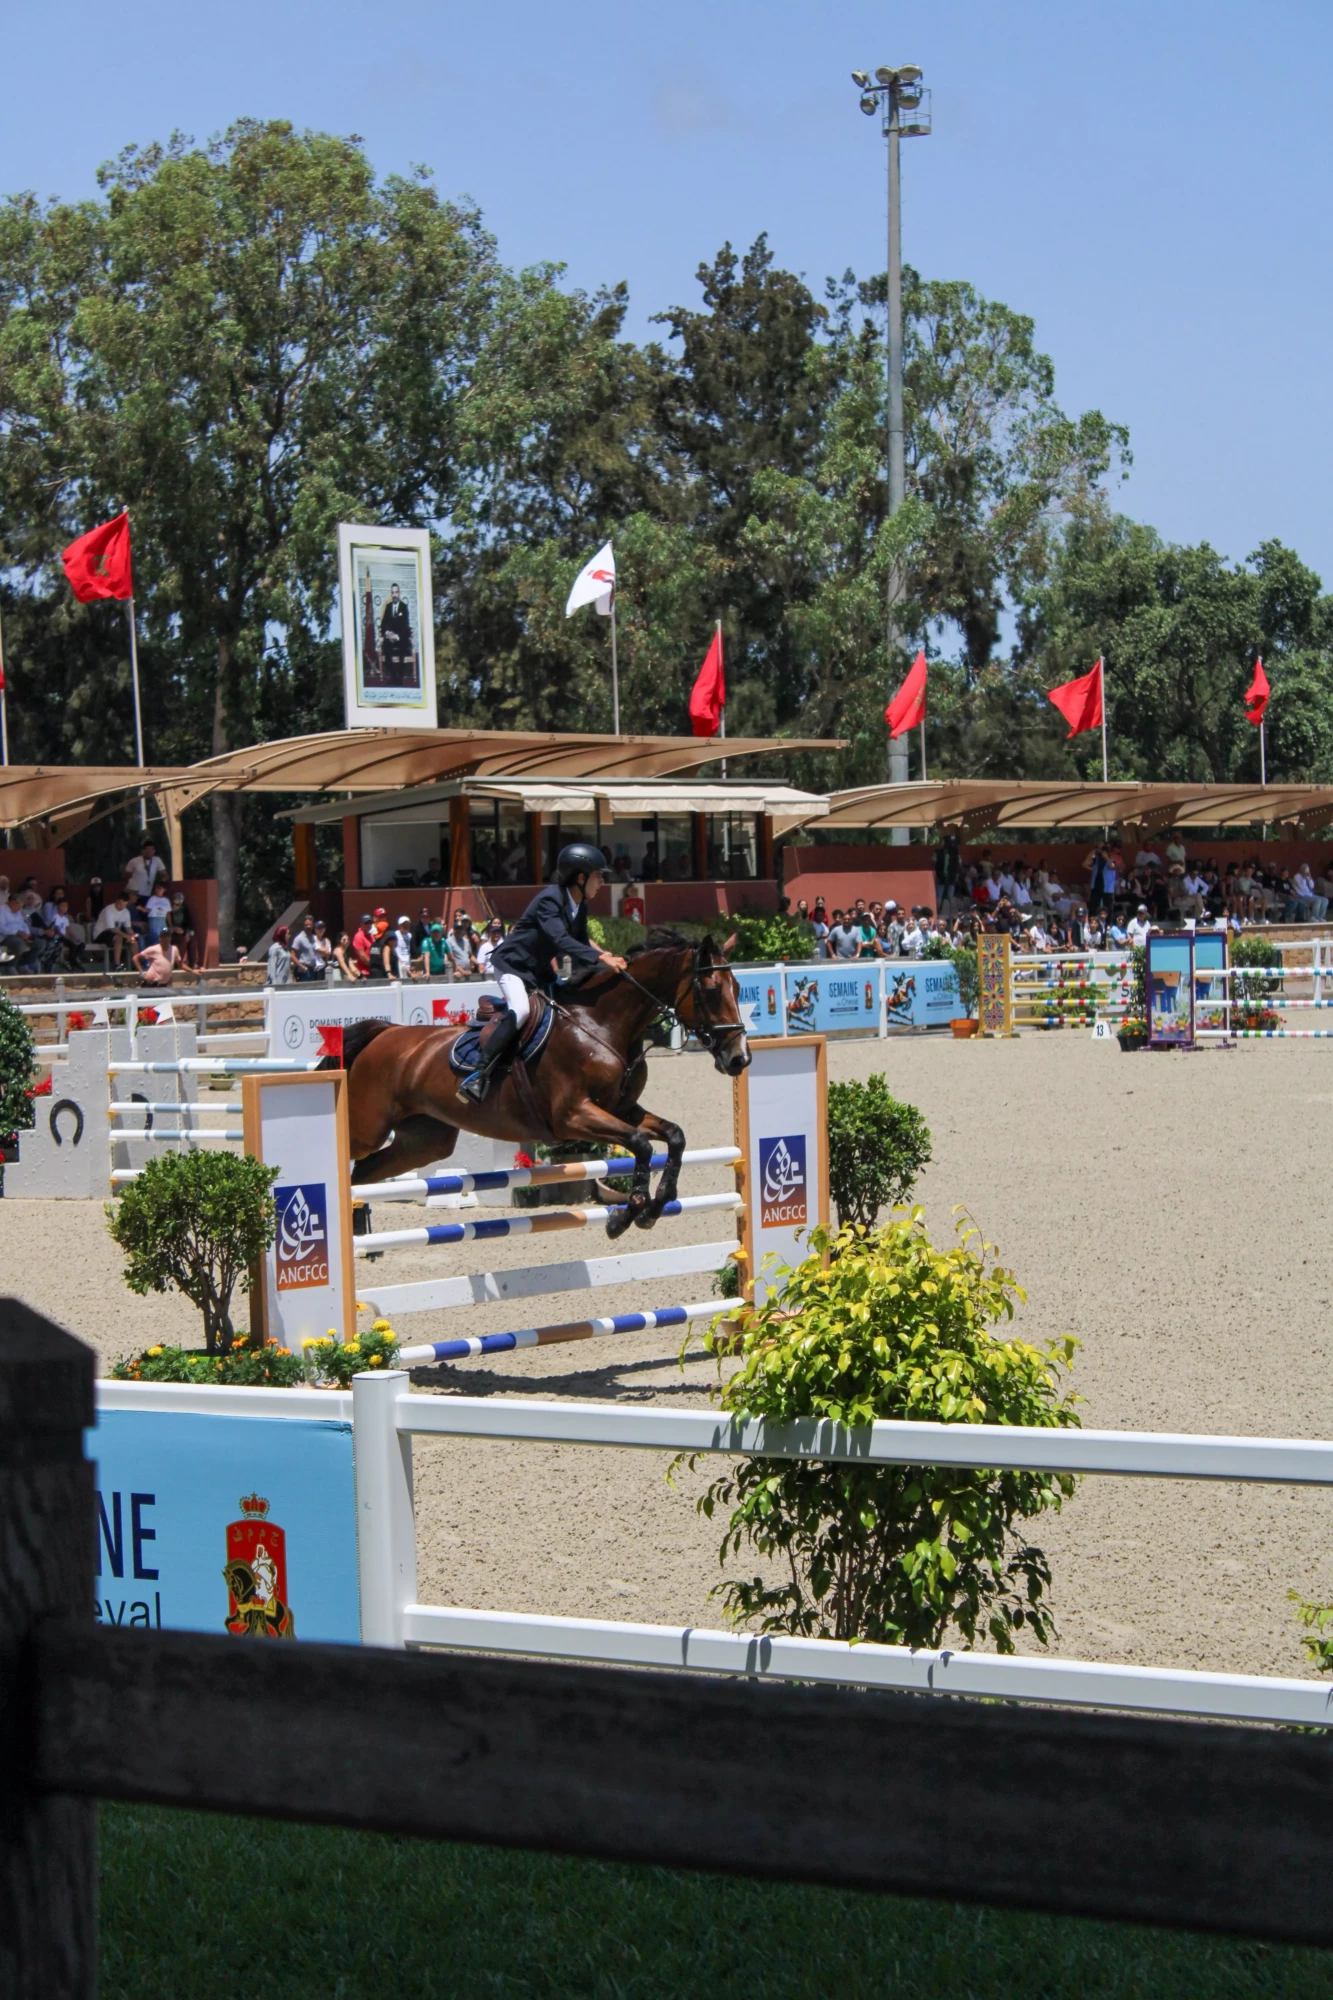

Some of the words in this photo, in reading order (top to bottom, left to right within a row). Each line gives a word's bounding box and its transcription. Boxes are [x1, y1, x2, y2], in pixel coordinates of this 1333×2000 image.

[738, 985, 760, 1002] MAINE
[829, 981, 858, 998] SEMAINE
[1096, 1024, 1104, 1037] 13
[762, 1204, 806, 1223] ANCFCC
[278, 1262, 328, 1285] ANCFCC
